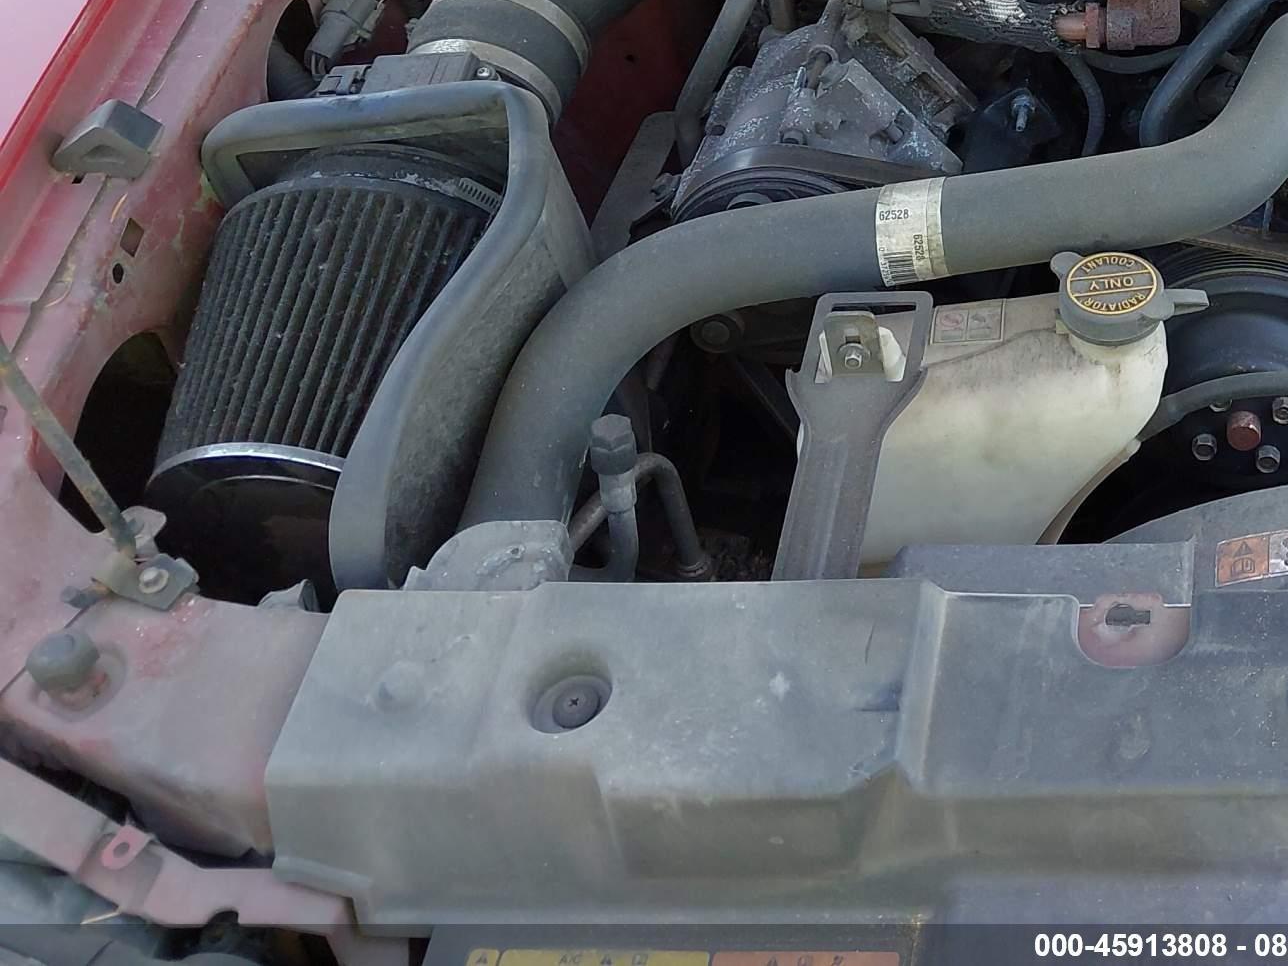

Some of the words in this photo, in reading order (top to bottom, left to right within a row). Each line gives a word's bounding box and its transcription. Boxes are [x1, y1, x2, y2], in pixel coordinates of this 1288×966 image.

[1081, 256, 1136, 274] COOLANT
[1090, 276, 1134, 291] ONLY
[1084, 291, 1147, 312] RADIATOR
